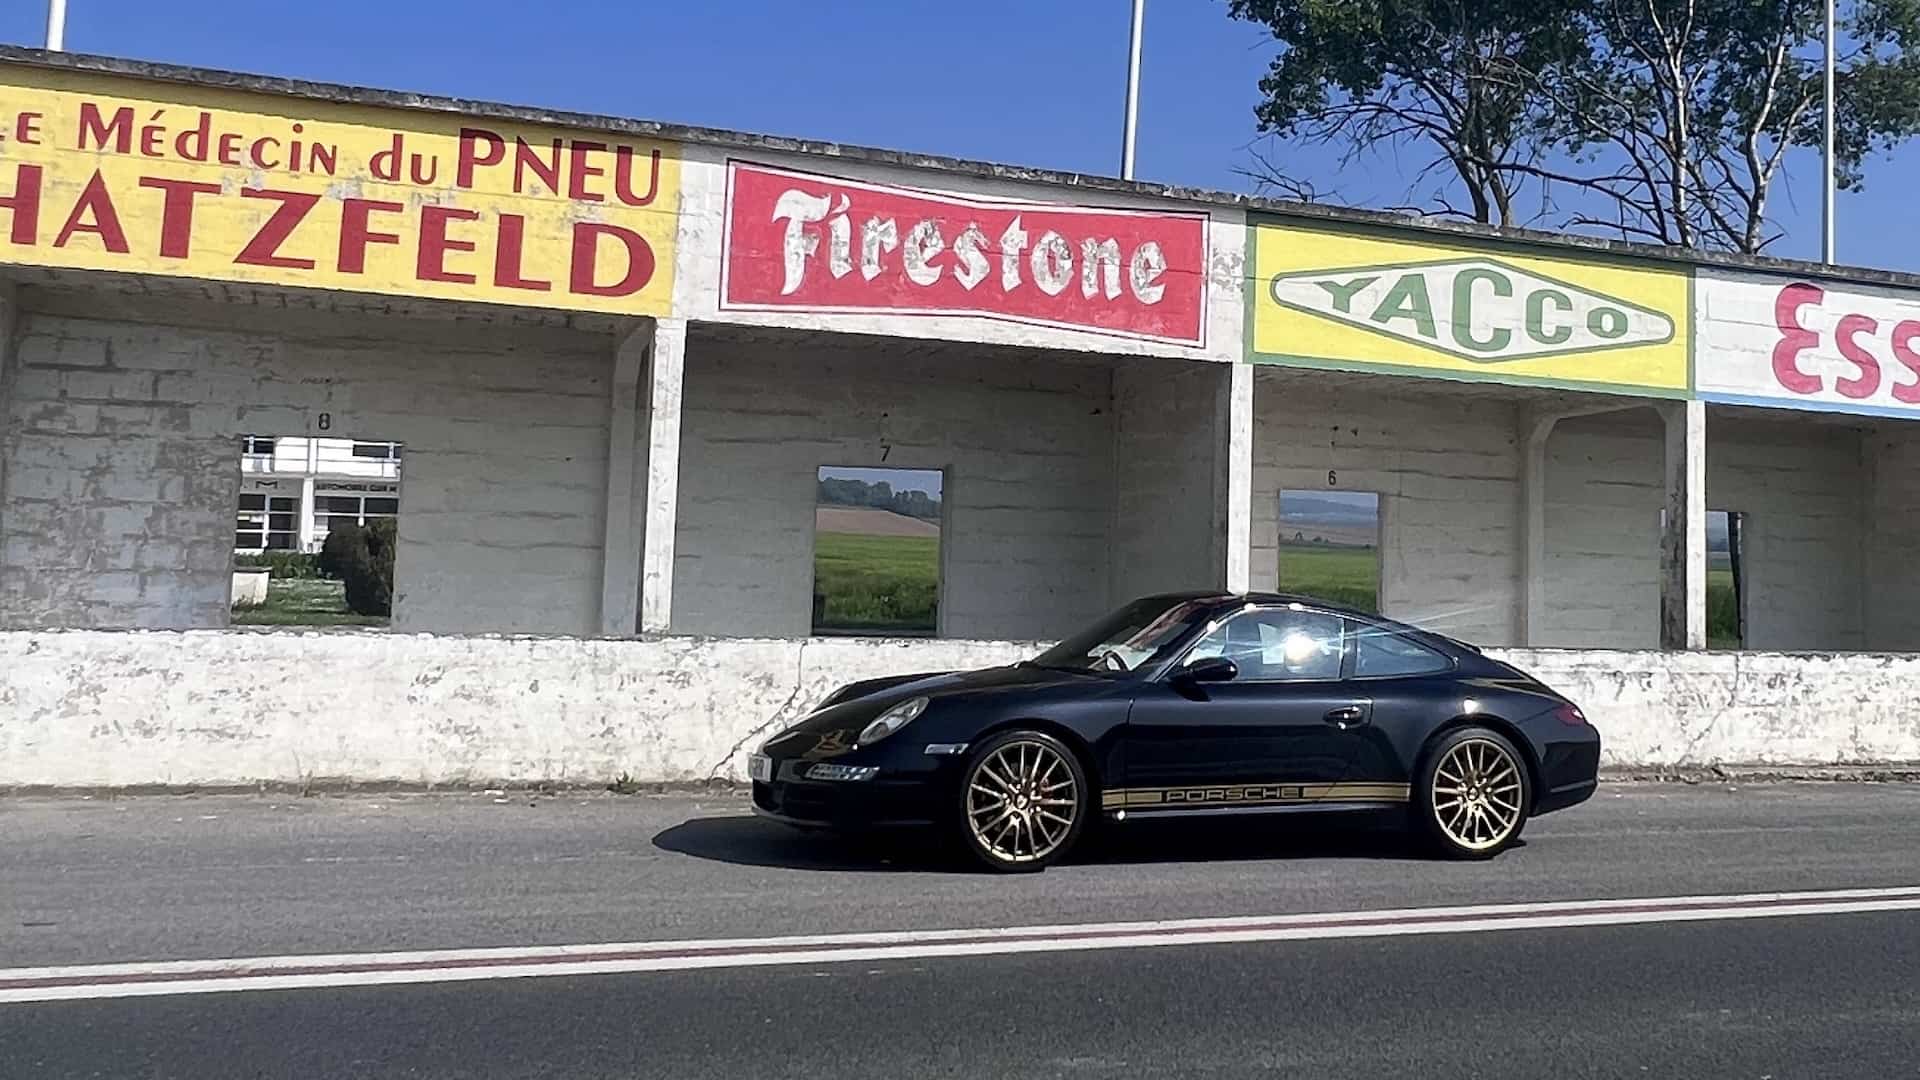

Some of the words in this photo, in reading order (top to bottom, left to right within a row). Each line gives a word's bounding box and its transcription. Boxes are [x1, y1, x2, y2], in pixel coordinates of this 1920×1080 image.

[369, 133, 437, 187] du
[456, 127, 661, 208] PNEU
[0, 163, 656, 298] HATZFELD
[771, 187, 1168, 306] Firestone
[1316, 265, 1630, 353] YACCO
[318, 412, 331, 430] 8
[879, 444, 892, 463] 7
[1327, 469, 1337, 486] 6
[1165, 786, 1300, 803] PORSCHE
